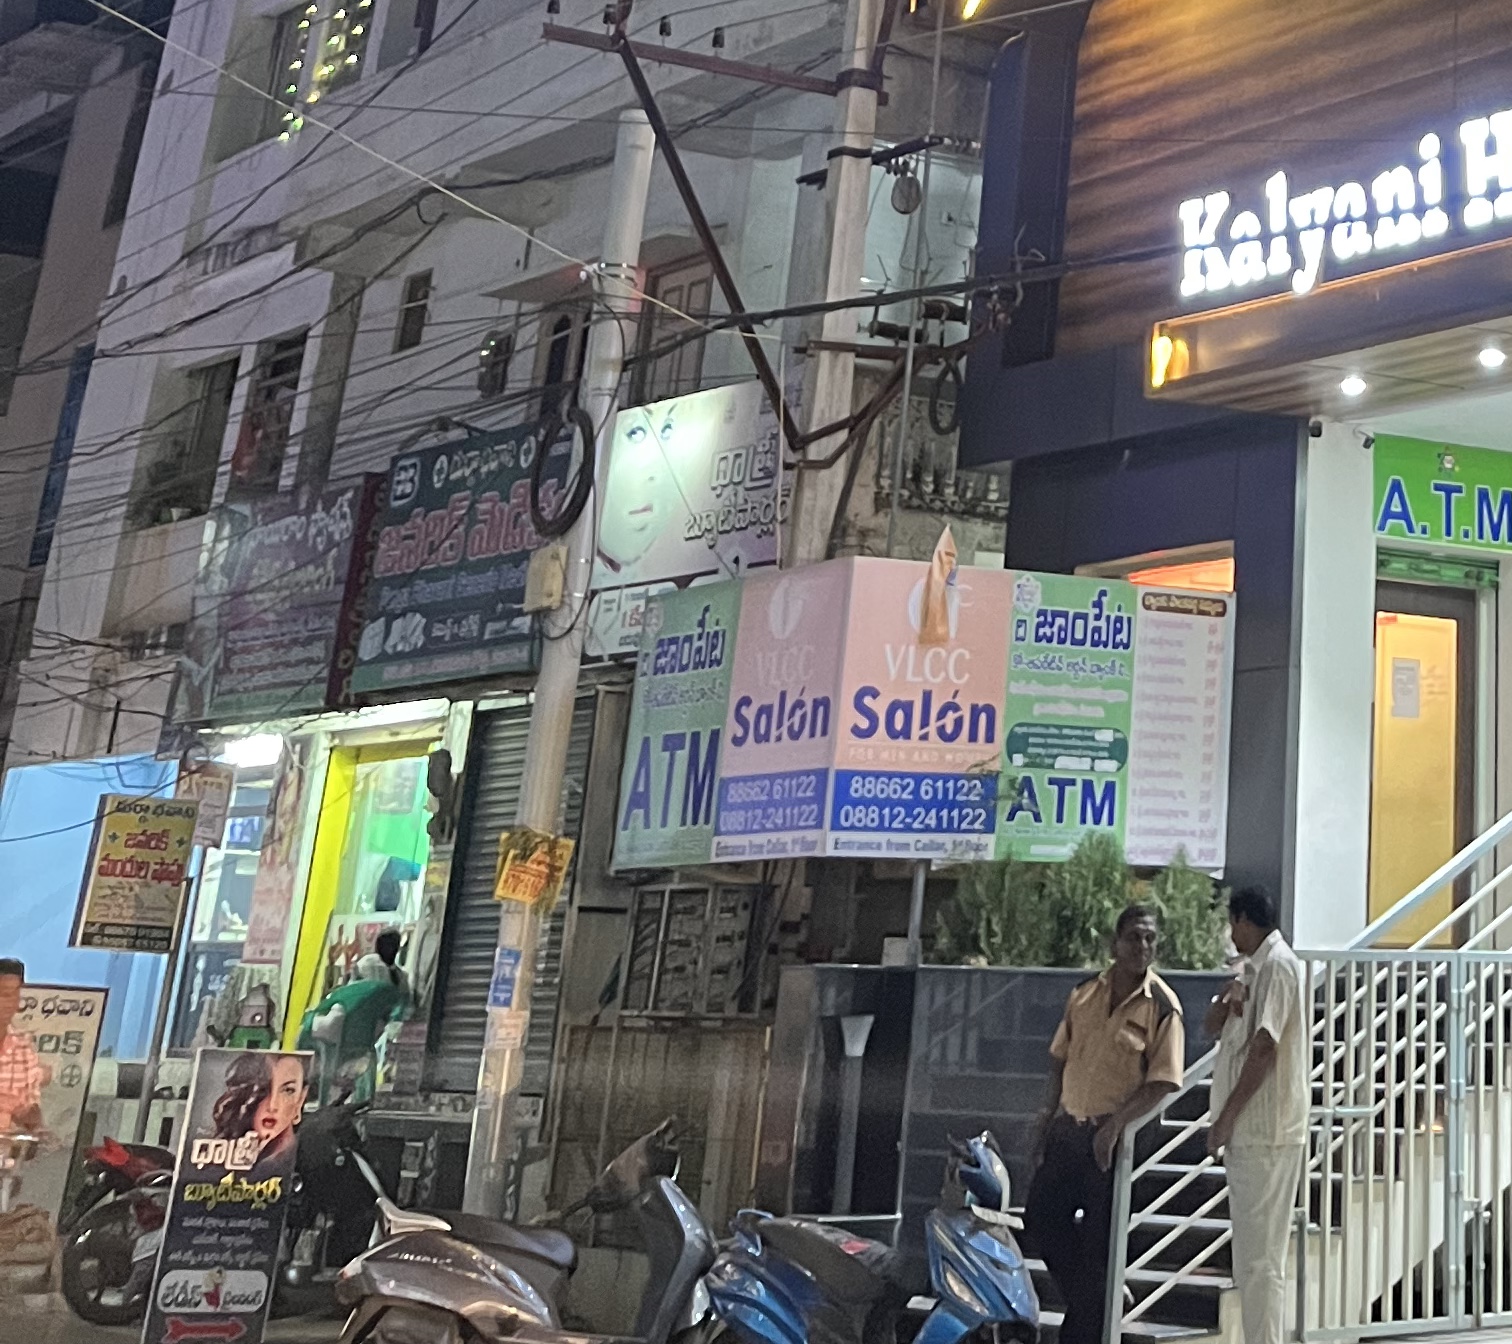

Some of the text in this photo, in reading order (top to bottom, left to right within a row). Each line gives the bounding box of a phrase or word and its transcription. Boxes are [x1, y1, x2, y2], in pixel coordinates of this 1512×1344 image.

[1178, 132, 1449, 296] Kalyani
[1033, 589, 1133, 650] జాంపేట
[885, 644, 971, 684] VLCC
[731, 686, 831, 747] Salón
[850, 686, 997, 744] Salón
[621, 727, 721, 831] ATM
[772, 775, 816, 799] 61122
[850, 776, 983, 802] 88662 61122
[1005, 775, 1117, 827] ATM
[839, 805, 987, 831] 08812-241122
[833, 838, 883, 852] Entrance
[885, 839, 910, 852] from
[40, 994, 96, 1020] భవాని
